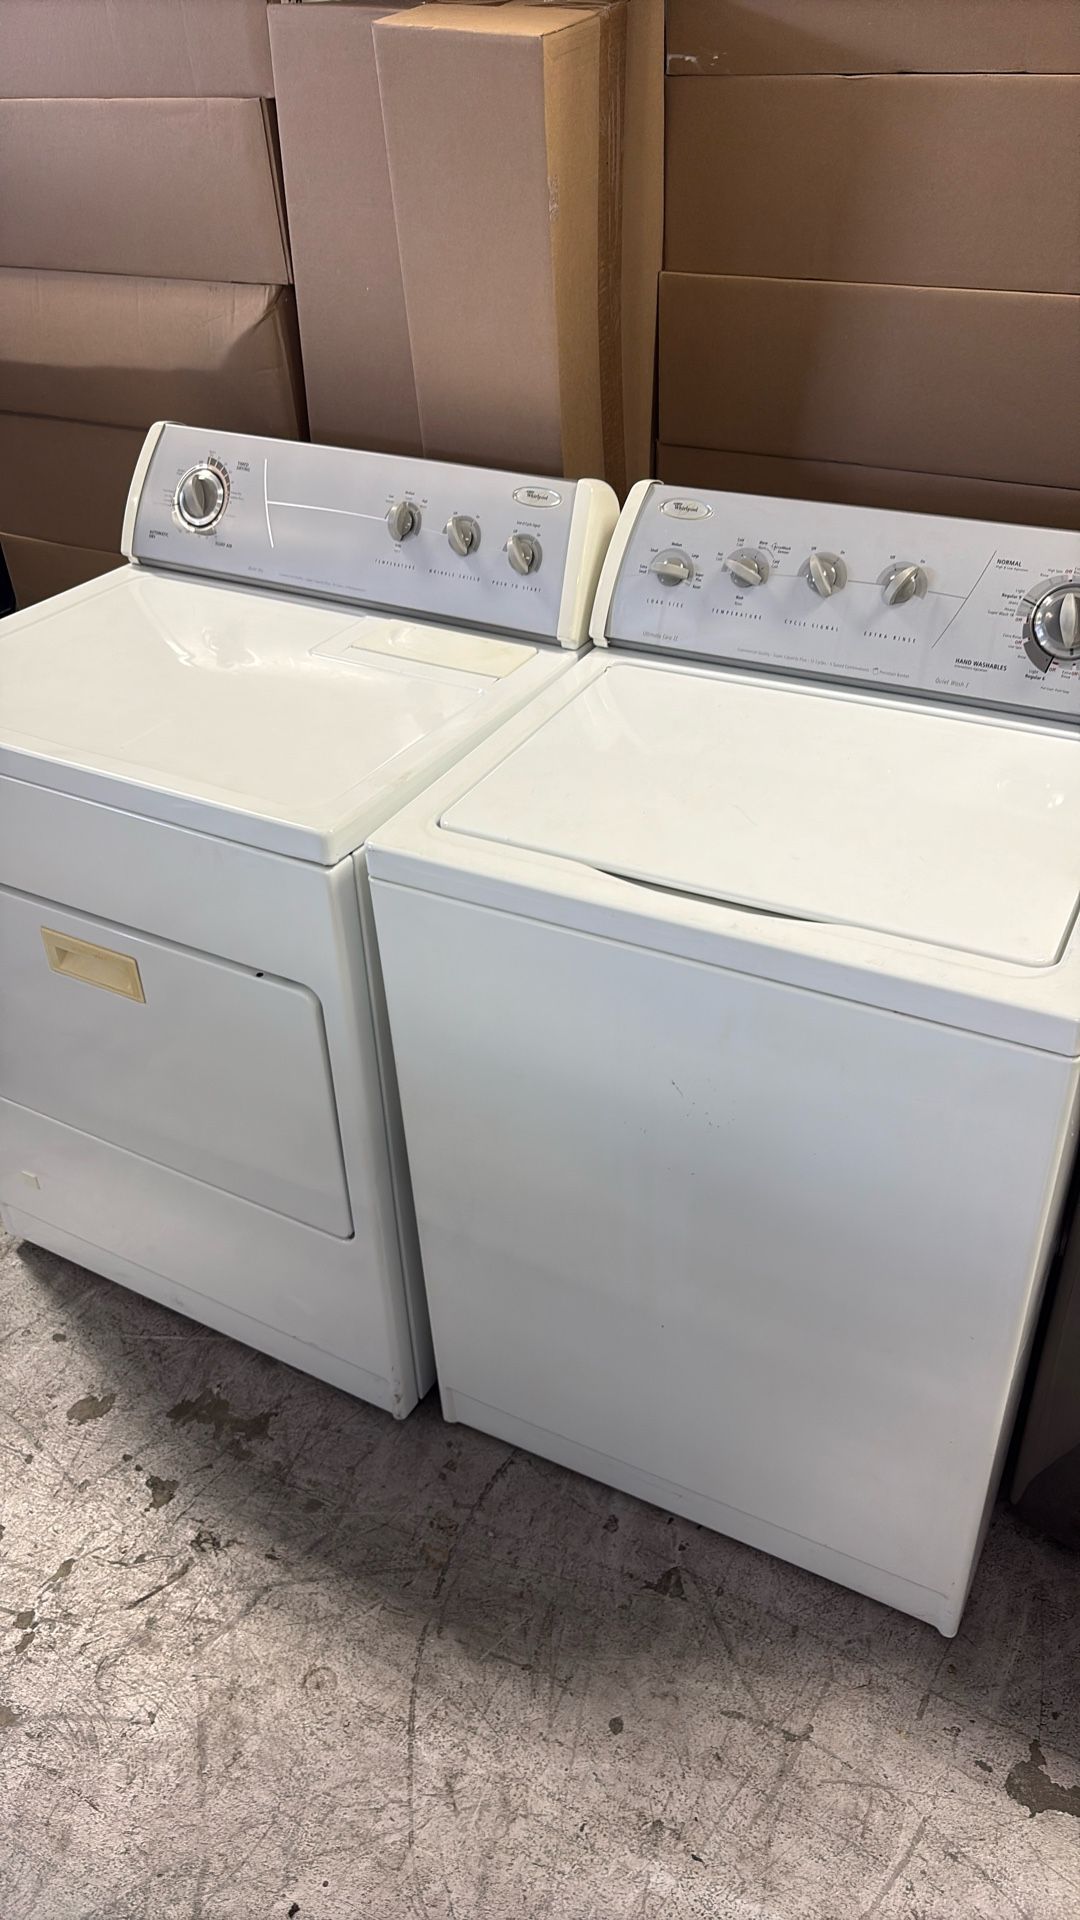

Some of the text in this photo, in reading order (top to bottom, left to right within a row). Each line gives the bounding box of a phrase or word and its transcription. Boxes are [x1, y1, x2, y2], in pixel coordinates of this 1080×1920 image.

[526, 490, 549, 501] Whirlpool
[673, 502, 699, 513] Whirlpool
[996, 558, 1023, 567] NORMAL
[1001, 592, 1019, 600] Regular
[646, 598, 664, 606] LOAD
[711, 607, 762, 621] TEMPERATURE
[784, 618, 839, 633] CYCLE SIGNAL
[863, 630, 916, 644] EXTRA RINSE
[954, 657, 1008, 672] HAND WASHABLES
[1024, 673, 1042, 681] Regular
